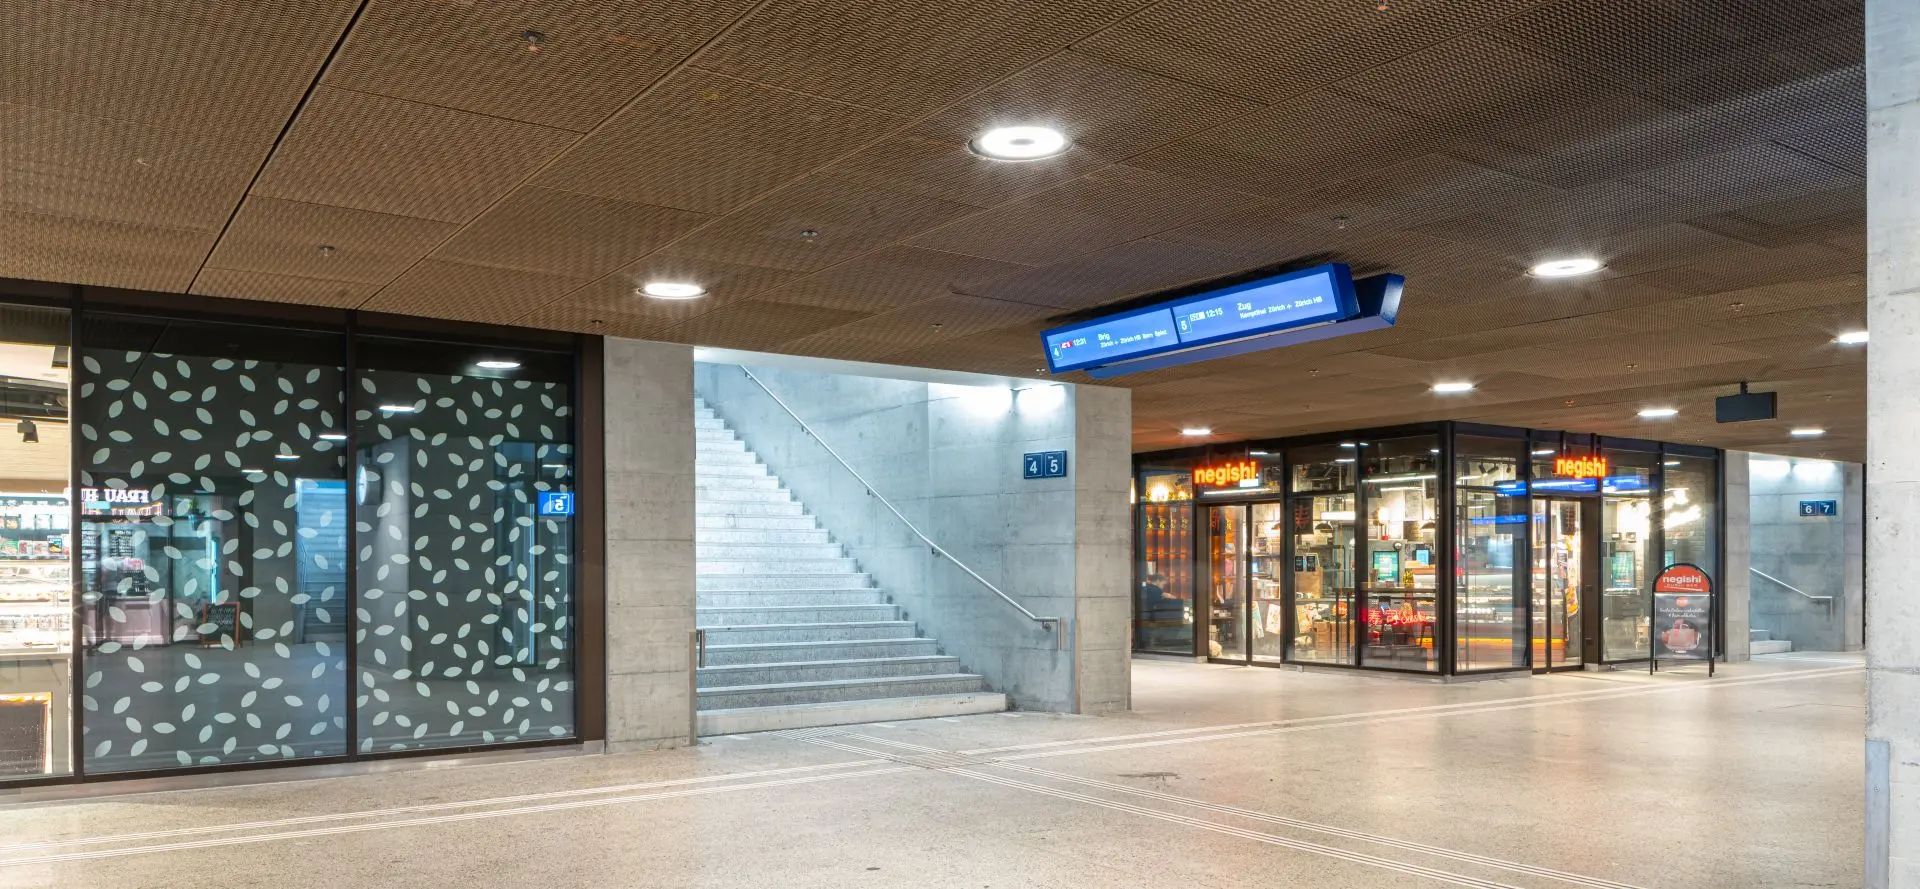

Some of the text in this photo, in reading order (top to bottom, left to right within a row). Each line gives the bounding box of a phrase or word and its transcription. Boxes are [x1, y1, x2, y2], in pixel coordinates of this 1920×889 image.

[1313, 295, 1323, 304] HB
[1205, 307, 1224, 319] 12:15
[1237, 302, 1252, 311] Zug
[1180, 320, 1188, 331] 5
[1097, 333, 1111, 341] Brig
[1029, 460, 1038, 474] 4
[1050, 459, 1058, 473] 5
[1556, 456, 1607, 479] negishi
[1194, 461, 1257, 486] negishi
[1805, 505, 1812, 514] 6
[1823, 504, 1830, 513] 7
[1662, 575, 1702, 584] negishi
